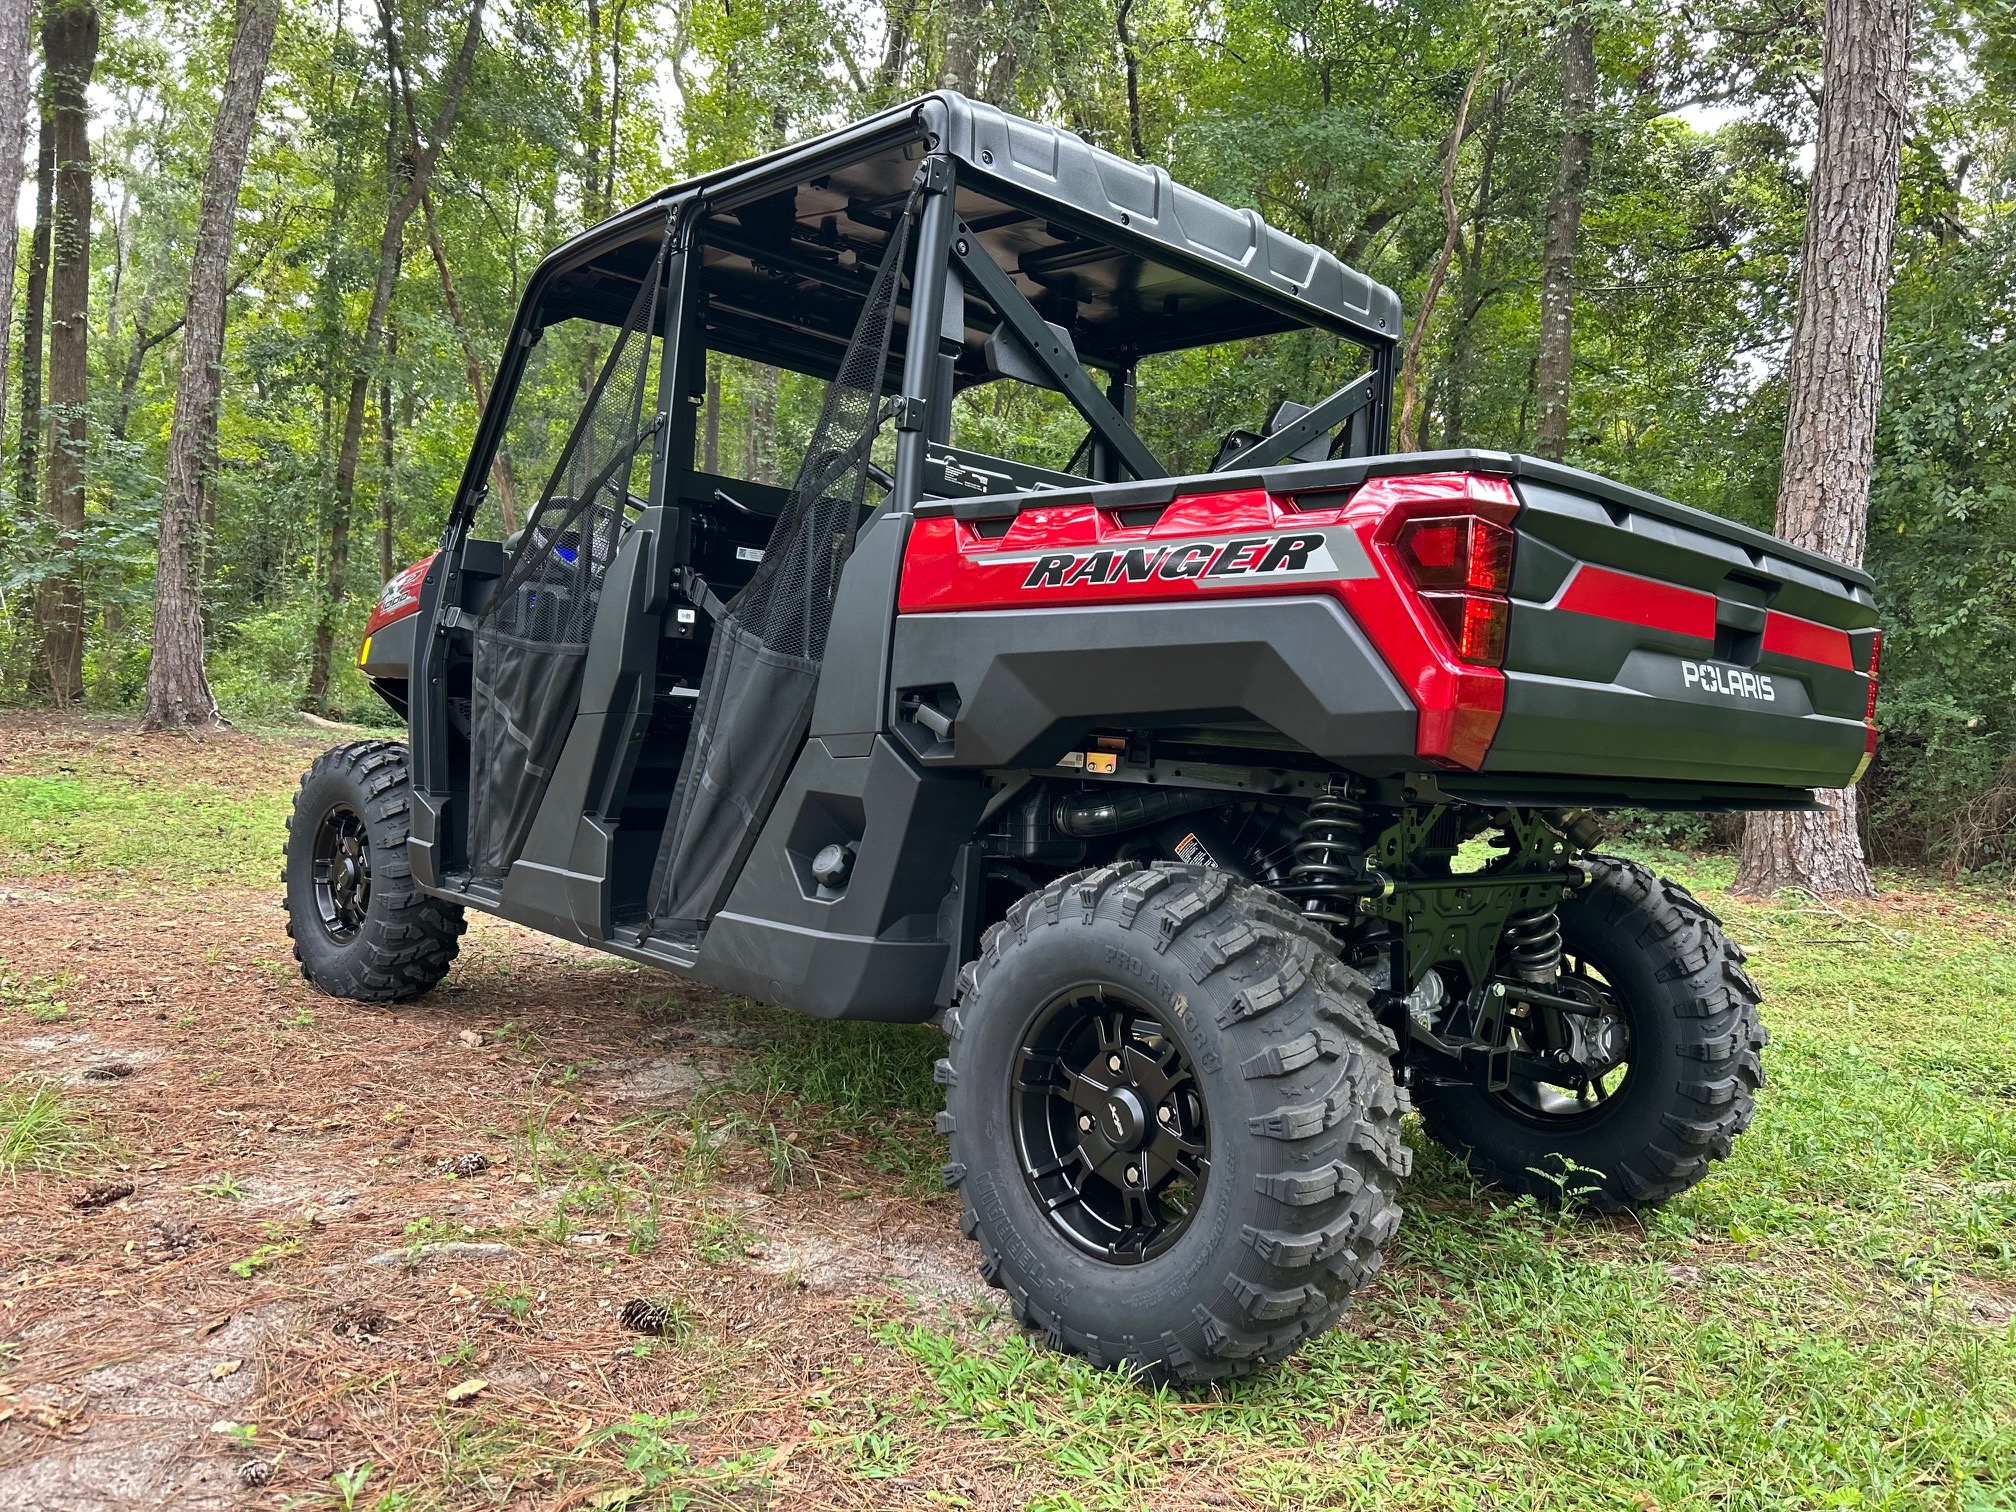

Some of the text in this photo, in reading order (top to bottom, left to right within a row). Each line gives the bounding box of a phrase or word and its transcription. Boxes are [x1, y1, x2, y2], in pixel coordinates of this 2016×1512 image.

[1021, 532, 1327, 589] RANGER
[1681, 660, 1775, 702] POLARIS
[1104, 944, 1208, 1051] PRO ARMOR
[975, 1170, 1076, 1308] X-TERRAIN
